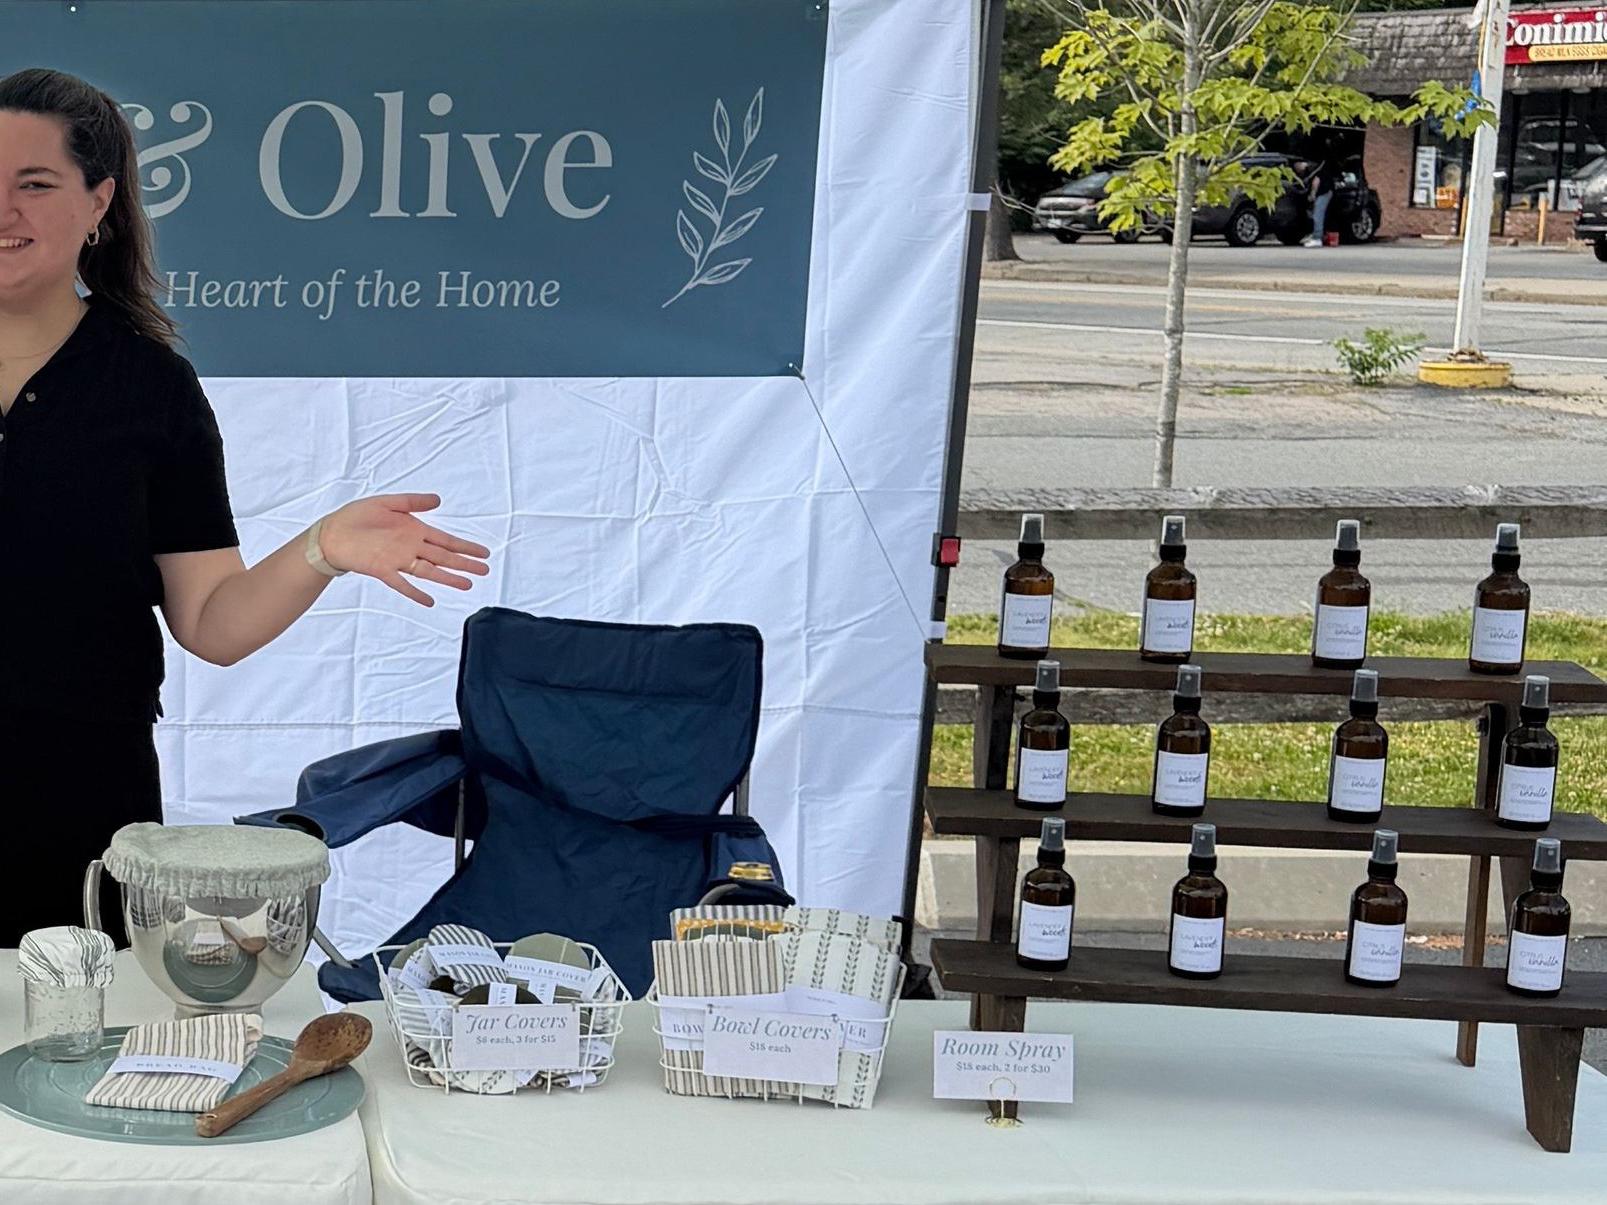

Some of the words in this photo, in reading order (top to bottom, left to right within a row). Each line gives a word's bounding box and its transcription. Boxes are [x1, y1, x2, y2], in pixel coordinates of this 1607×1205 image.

[121, 100, 213, 219] &
[258, 90, 613, 220] Olive
[163, 271, 289, 308] Heart
[301, 268, 346, 320] of
[355, 268, 421, 308] the
[435, 270, 561, 308] Home
[538, 967, 554, 976] JAR
[556, 971, 588, 983] COVER
[465, 1014, 500, 1034] Jar
[504, 1013, 568, 1030] Covers
[672, 1023, 704, 1034] BOW
[712, 1016, 759, 1035] Bowl
[764, 1019, 832, 1040] Covers
[490, 1036, 514, 1044] each,
[525, 1035, 538, 1043] for
[541, 1034, 556, 1043] $15
[768, 1043, 792, 1053] each
[941, 1037, 999, 1056] Room
[1005, 1039, 1066, 1061] Spray
[975, 1062, 1002, 1072] each,
[1004, 1063, 1011, 1071] 2
[1013, 1063, 1029, 1072] for
[1031, 1064, 1051, 1073] $30
